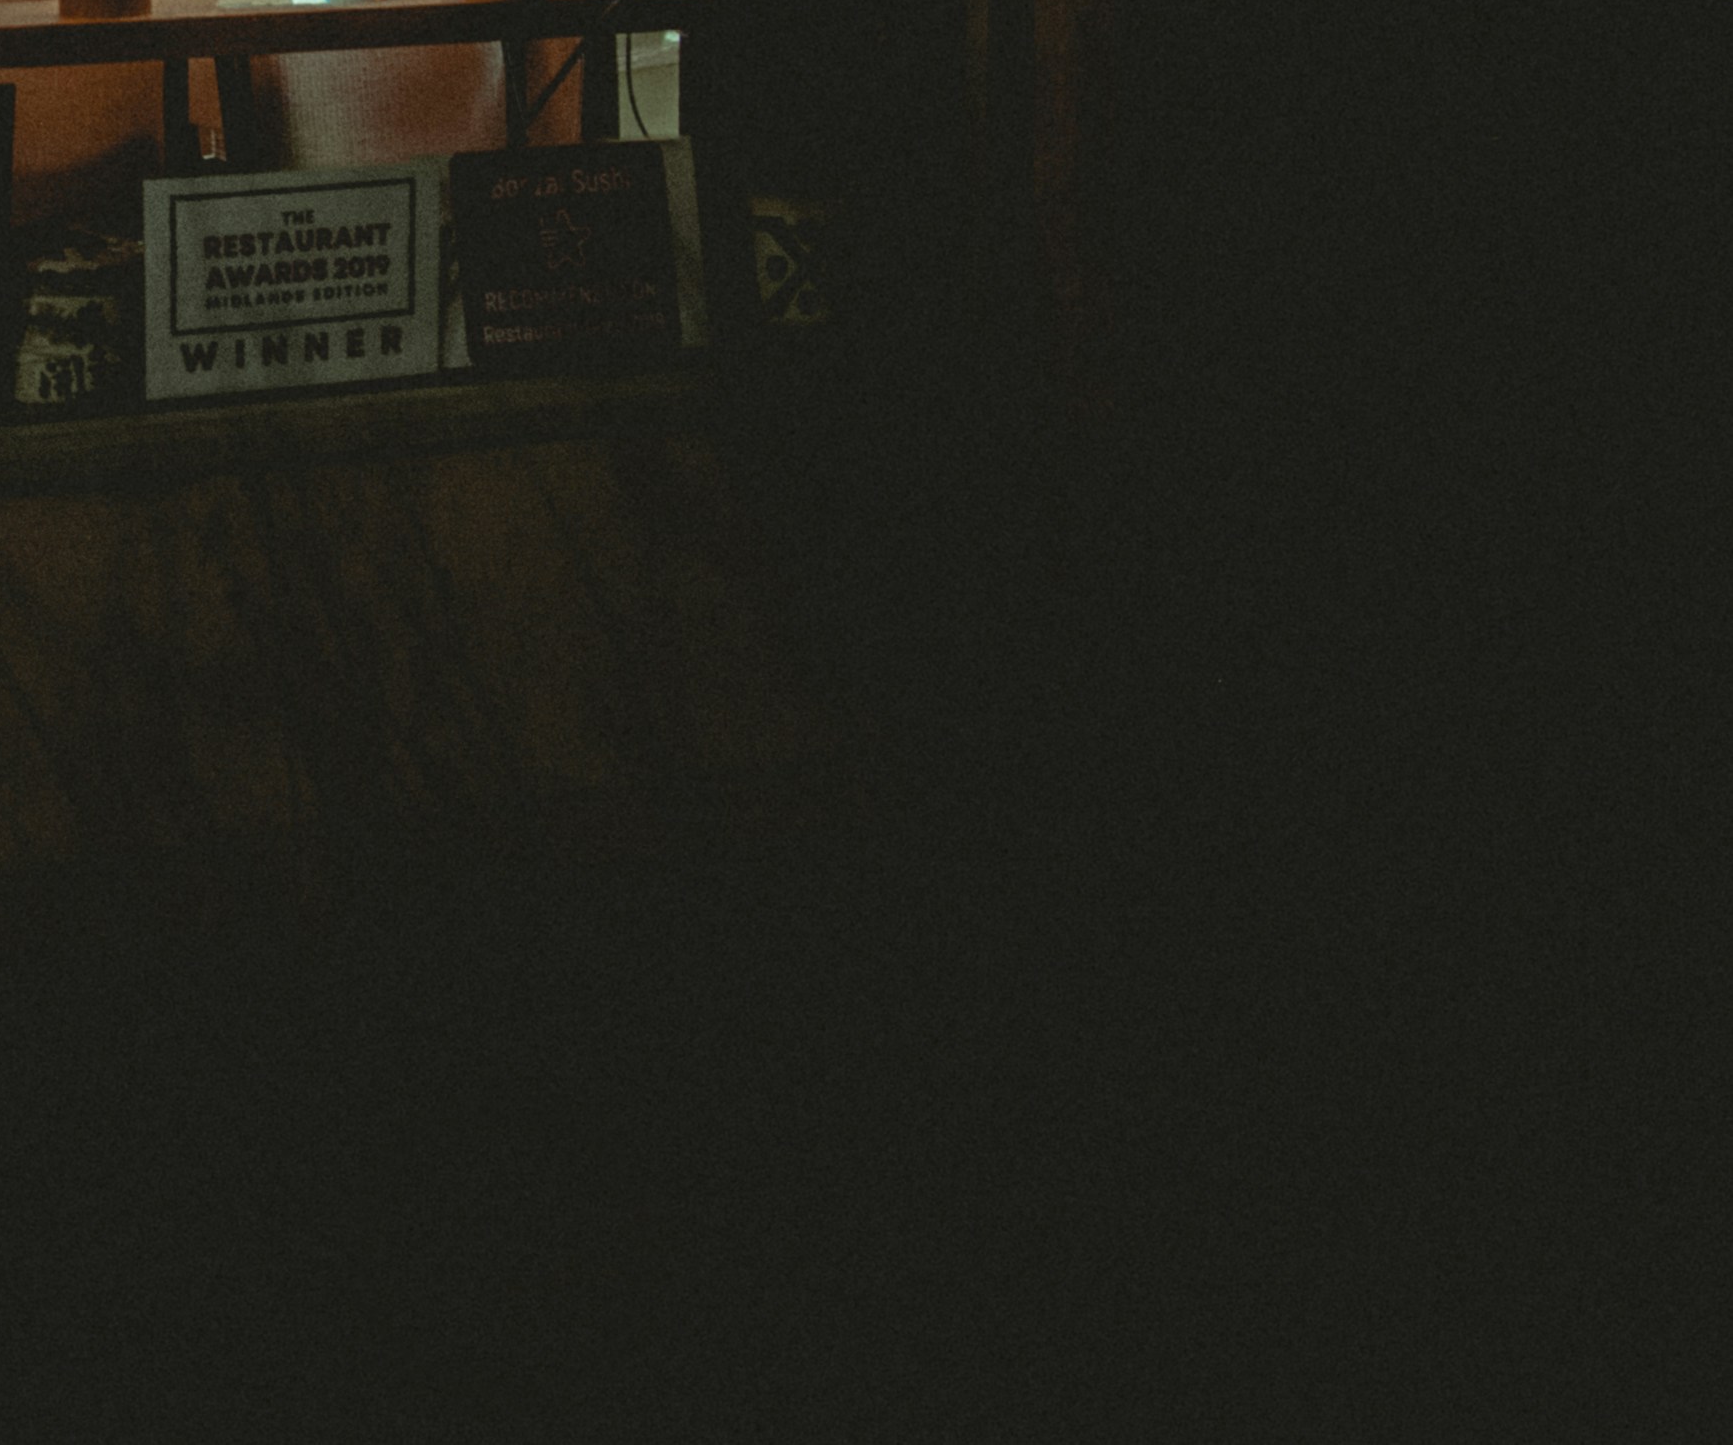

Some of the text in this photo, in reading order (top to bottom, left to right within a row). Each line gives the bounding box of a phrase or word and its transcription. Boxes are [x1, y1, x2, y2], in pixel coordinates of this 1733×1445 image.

[570, 165, 632, 195] Sushi
[280, 209, 315, 226] THE
[202, 222, 392, 259] RESTAURANT
[204, 259, 329, 291] AWARDS
[204, 282, 389, 311] MIDLANDS EDITION
[179, 324, 404, 375] WINNER
